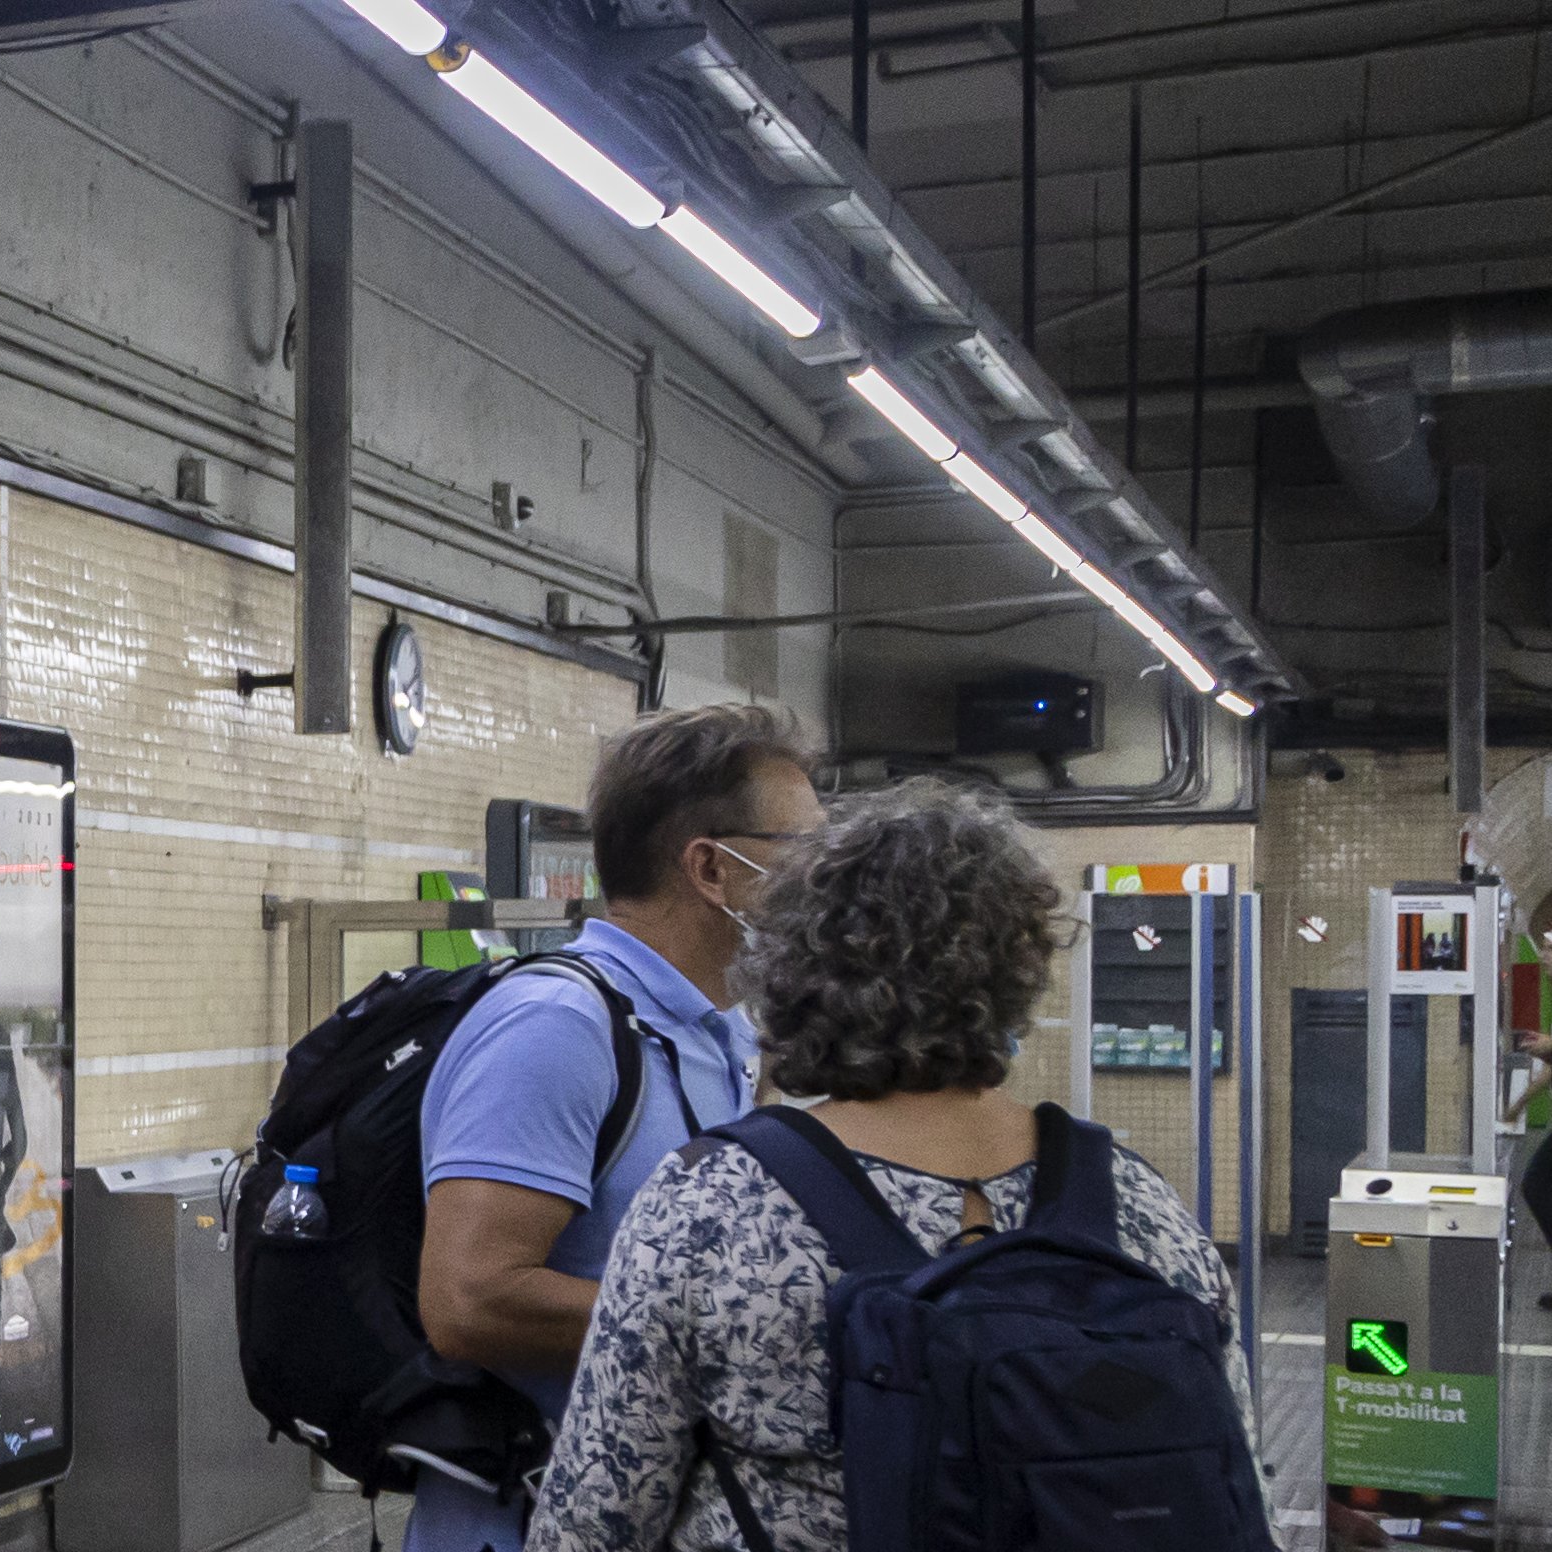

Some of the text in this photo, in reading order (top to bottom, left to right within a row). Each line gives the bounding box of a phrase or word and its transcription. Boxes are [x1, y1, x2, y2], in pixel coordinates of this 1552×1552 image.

[1336, 1376, 1463, 1402] Passa't a la
[1335, 1396, 1468, 1424] T-mobilitat
